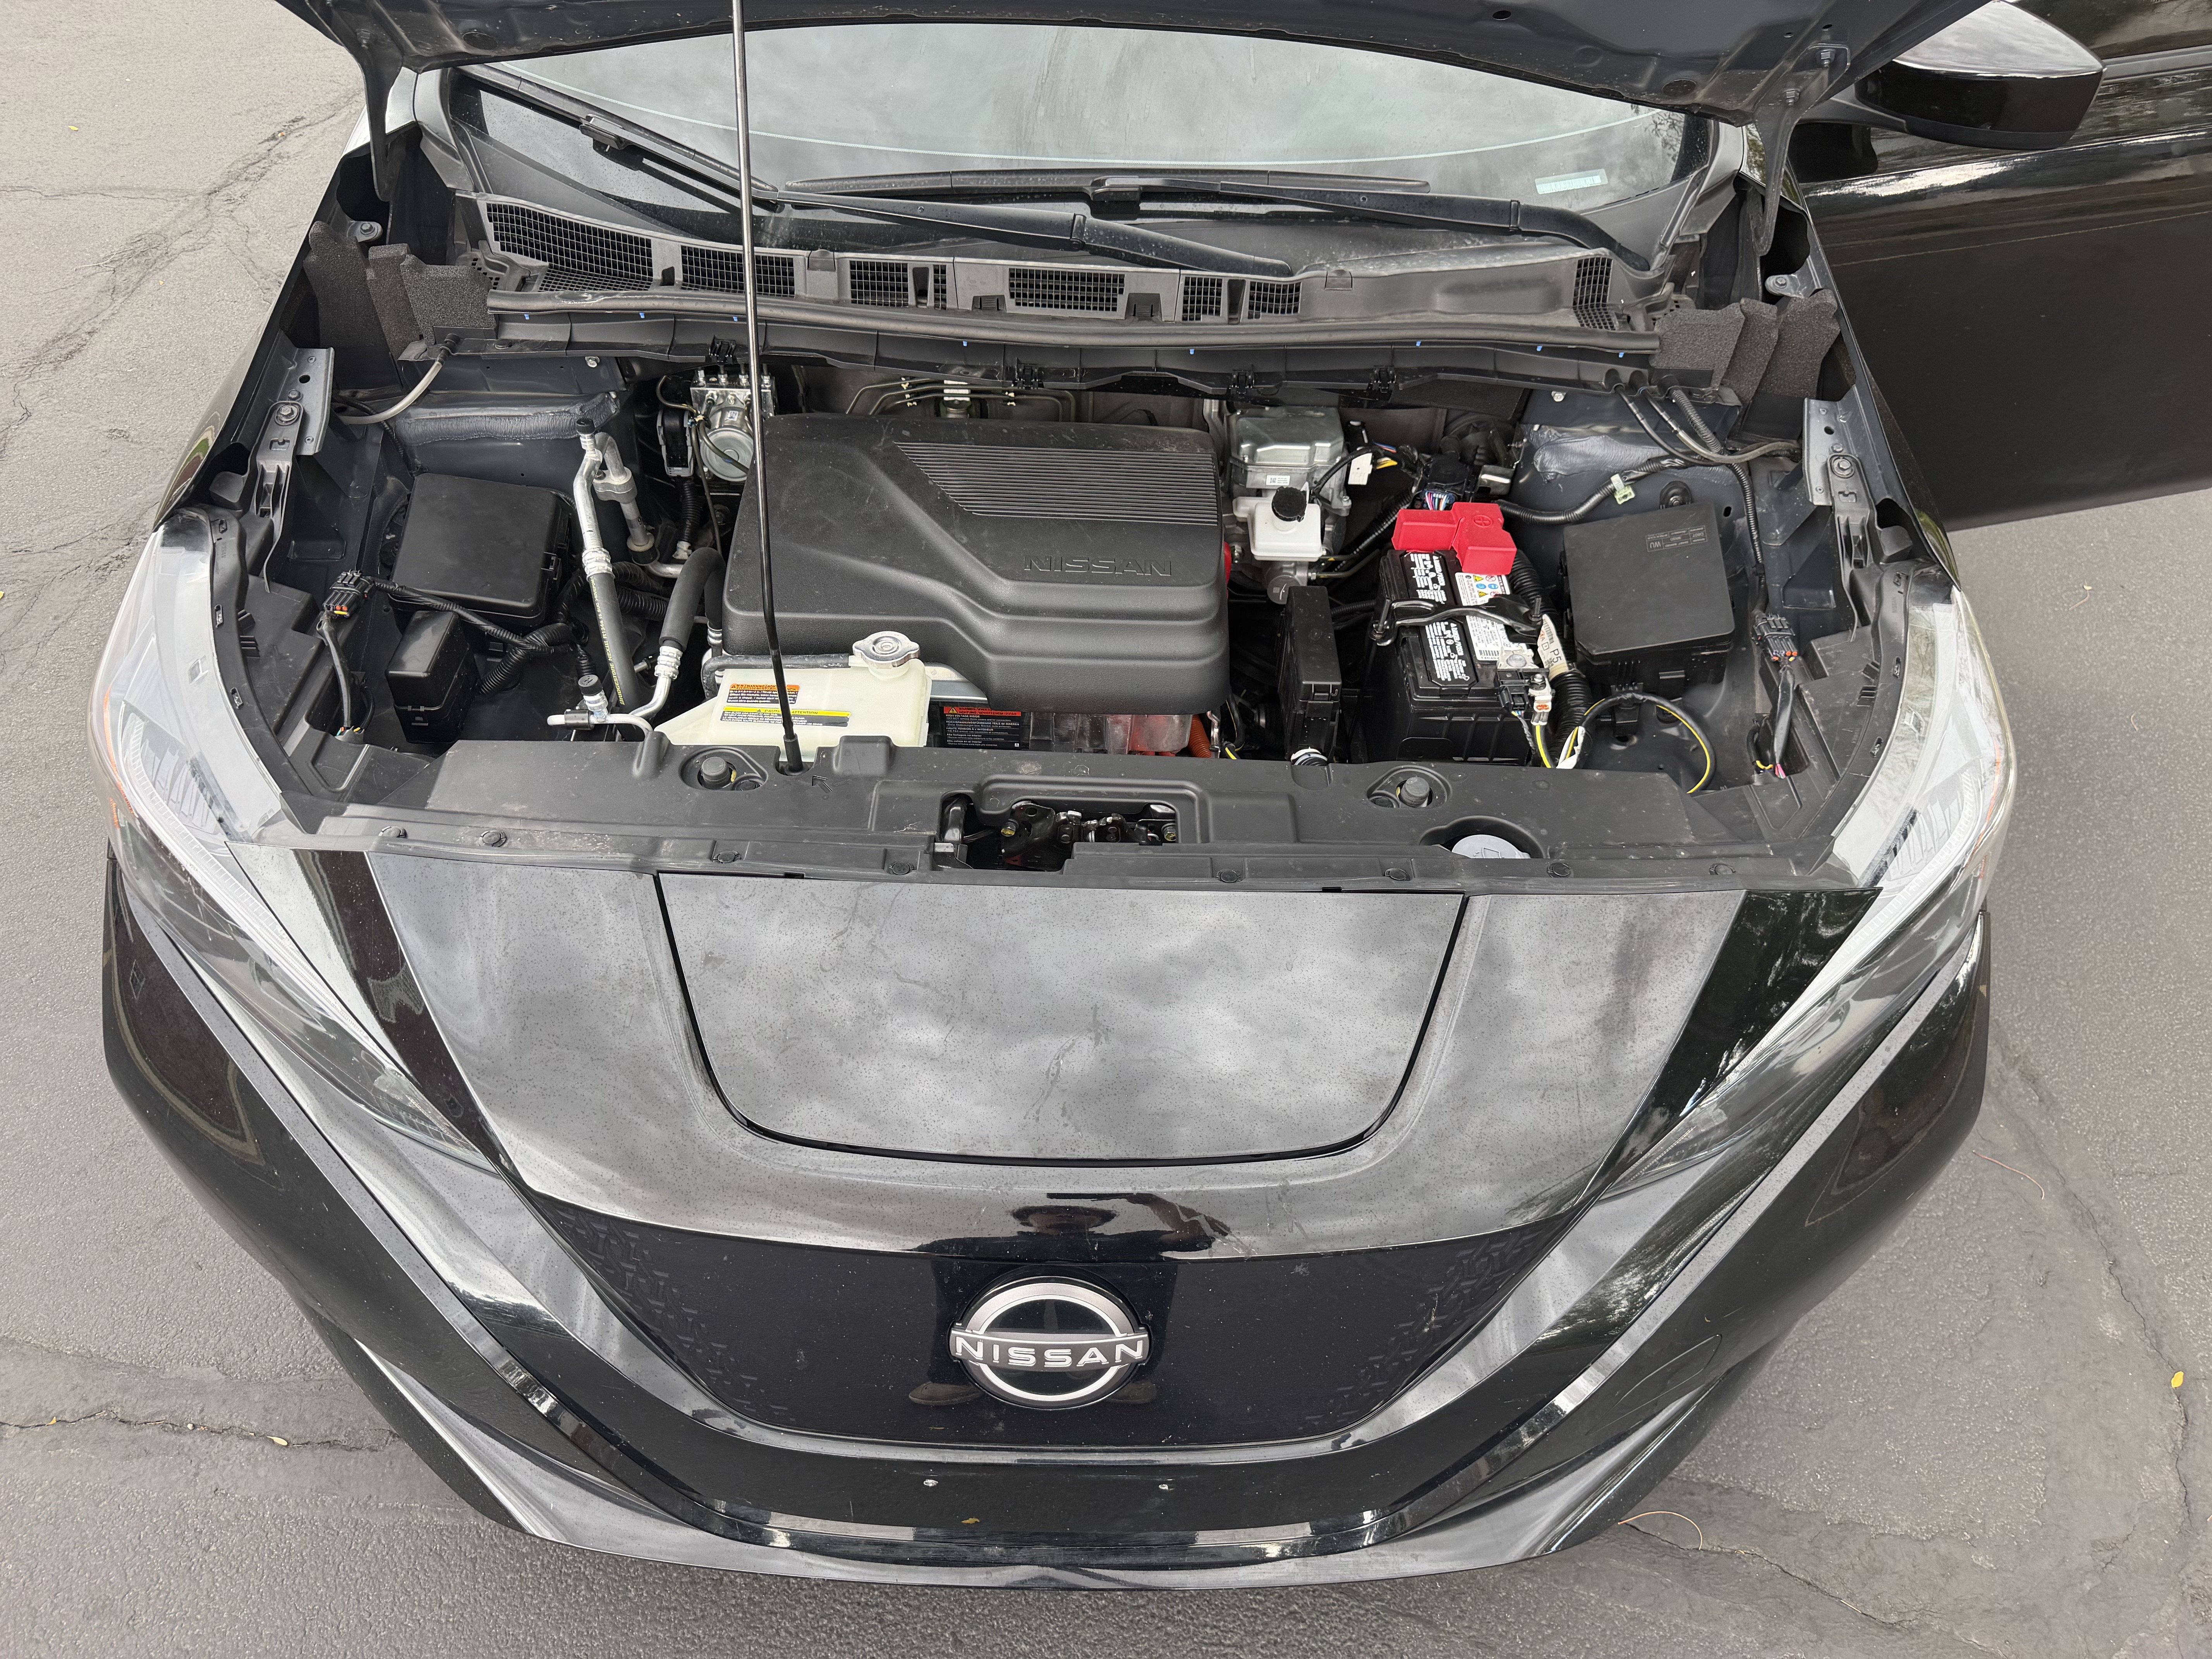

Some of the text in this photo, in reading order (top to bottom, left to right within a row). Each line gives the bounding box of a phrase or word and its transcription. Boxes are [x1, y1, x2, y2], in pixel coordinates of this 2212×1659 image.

[1649, 541, 1661, 549] WU
[1024, 555, 1172, 577] NISSAN
[1549, 648, 1562, 663] P5
[609, 663, 625, 706] BRIDGESTONE
[955, 1336, 1144, 1368] NISSAN
